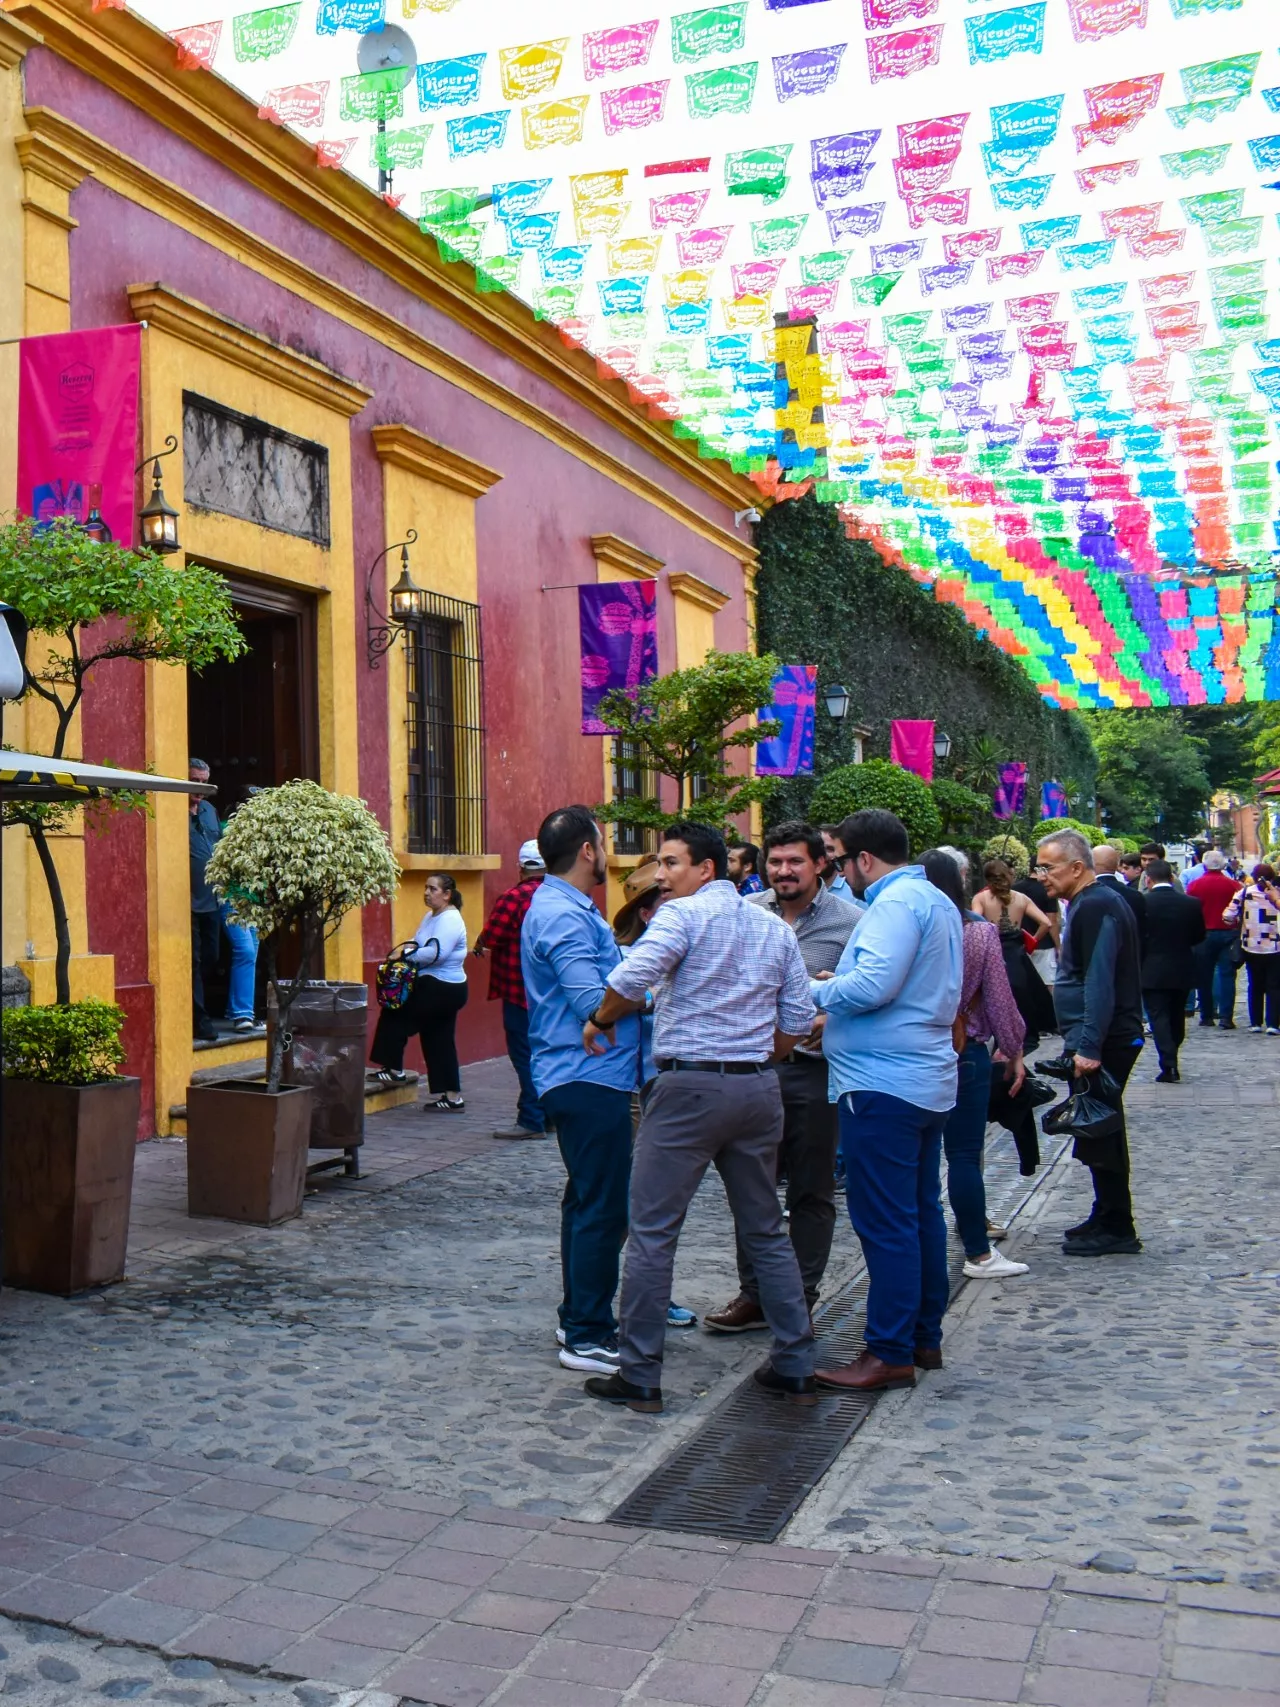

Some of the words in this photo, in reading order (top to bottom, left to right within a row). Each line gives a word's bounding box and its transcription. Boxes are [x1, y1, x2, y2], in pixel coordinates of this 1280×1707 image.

[681, 21, 739, 43] Reserva
[694, 81, 748, 99] Reserva
[1001, 115, 1056, 132] Reserva
[906, 133, 961, 150] Reserva
